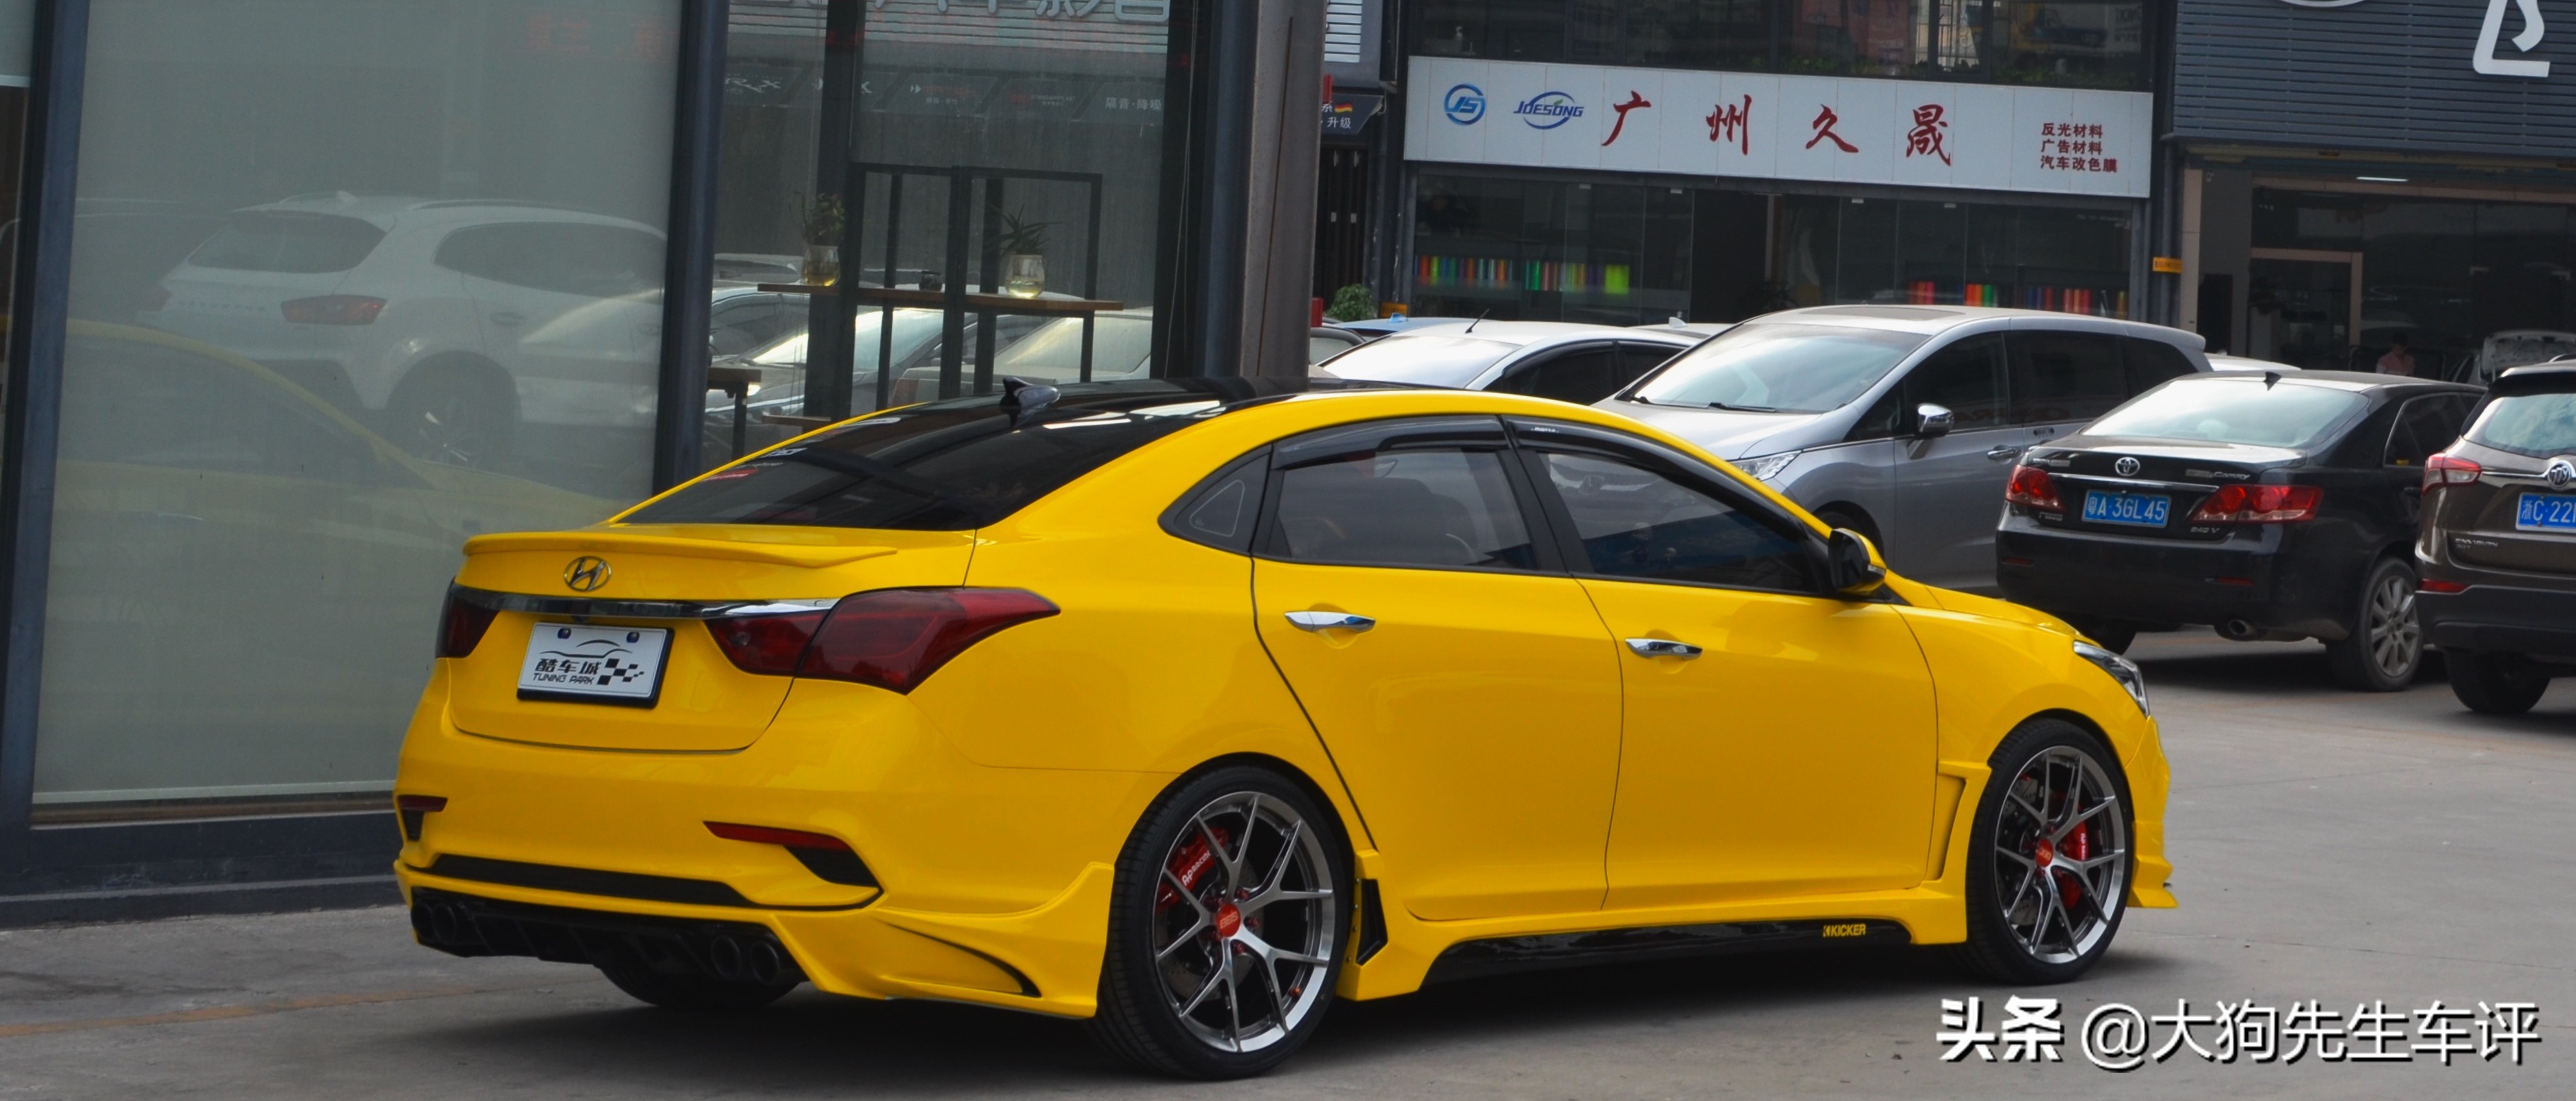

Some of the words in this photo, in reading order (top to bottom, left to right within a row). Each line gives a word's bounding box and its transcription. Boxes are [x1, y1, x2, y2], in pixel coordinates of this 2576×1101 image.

[1513, 101, 1584, 117] JOESONG
[1601, 91, 1951, 166] 广州久晟
[2042, 123, 2103, 139] 反光材料
[2041, 139, 2102, 155] 广告材料
[2041, 155, 2117, 172] 汽车改色膜
[2521, 499, 2576, 523] 浙C·22
[535, 658, 602, 675] 酷车城
[534, 672, 567, 683] TUNING
[569, 675, 594, 685] PARK
